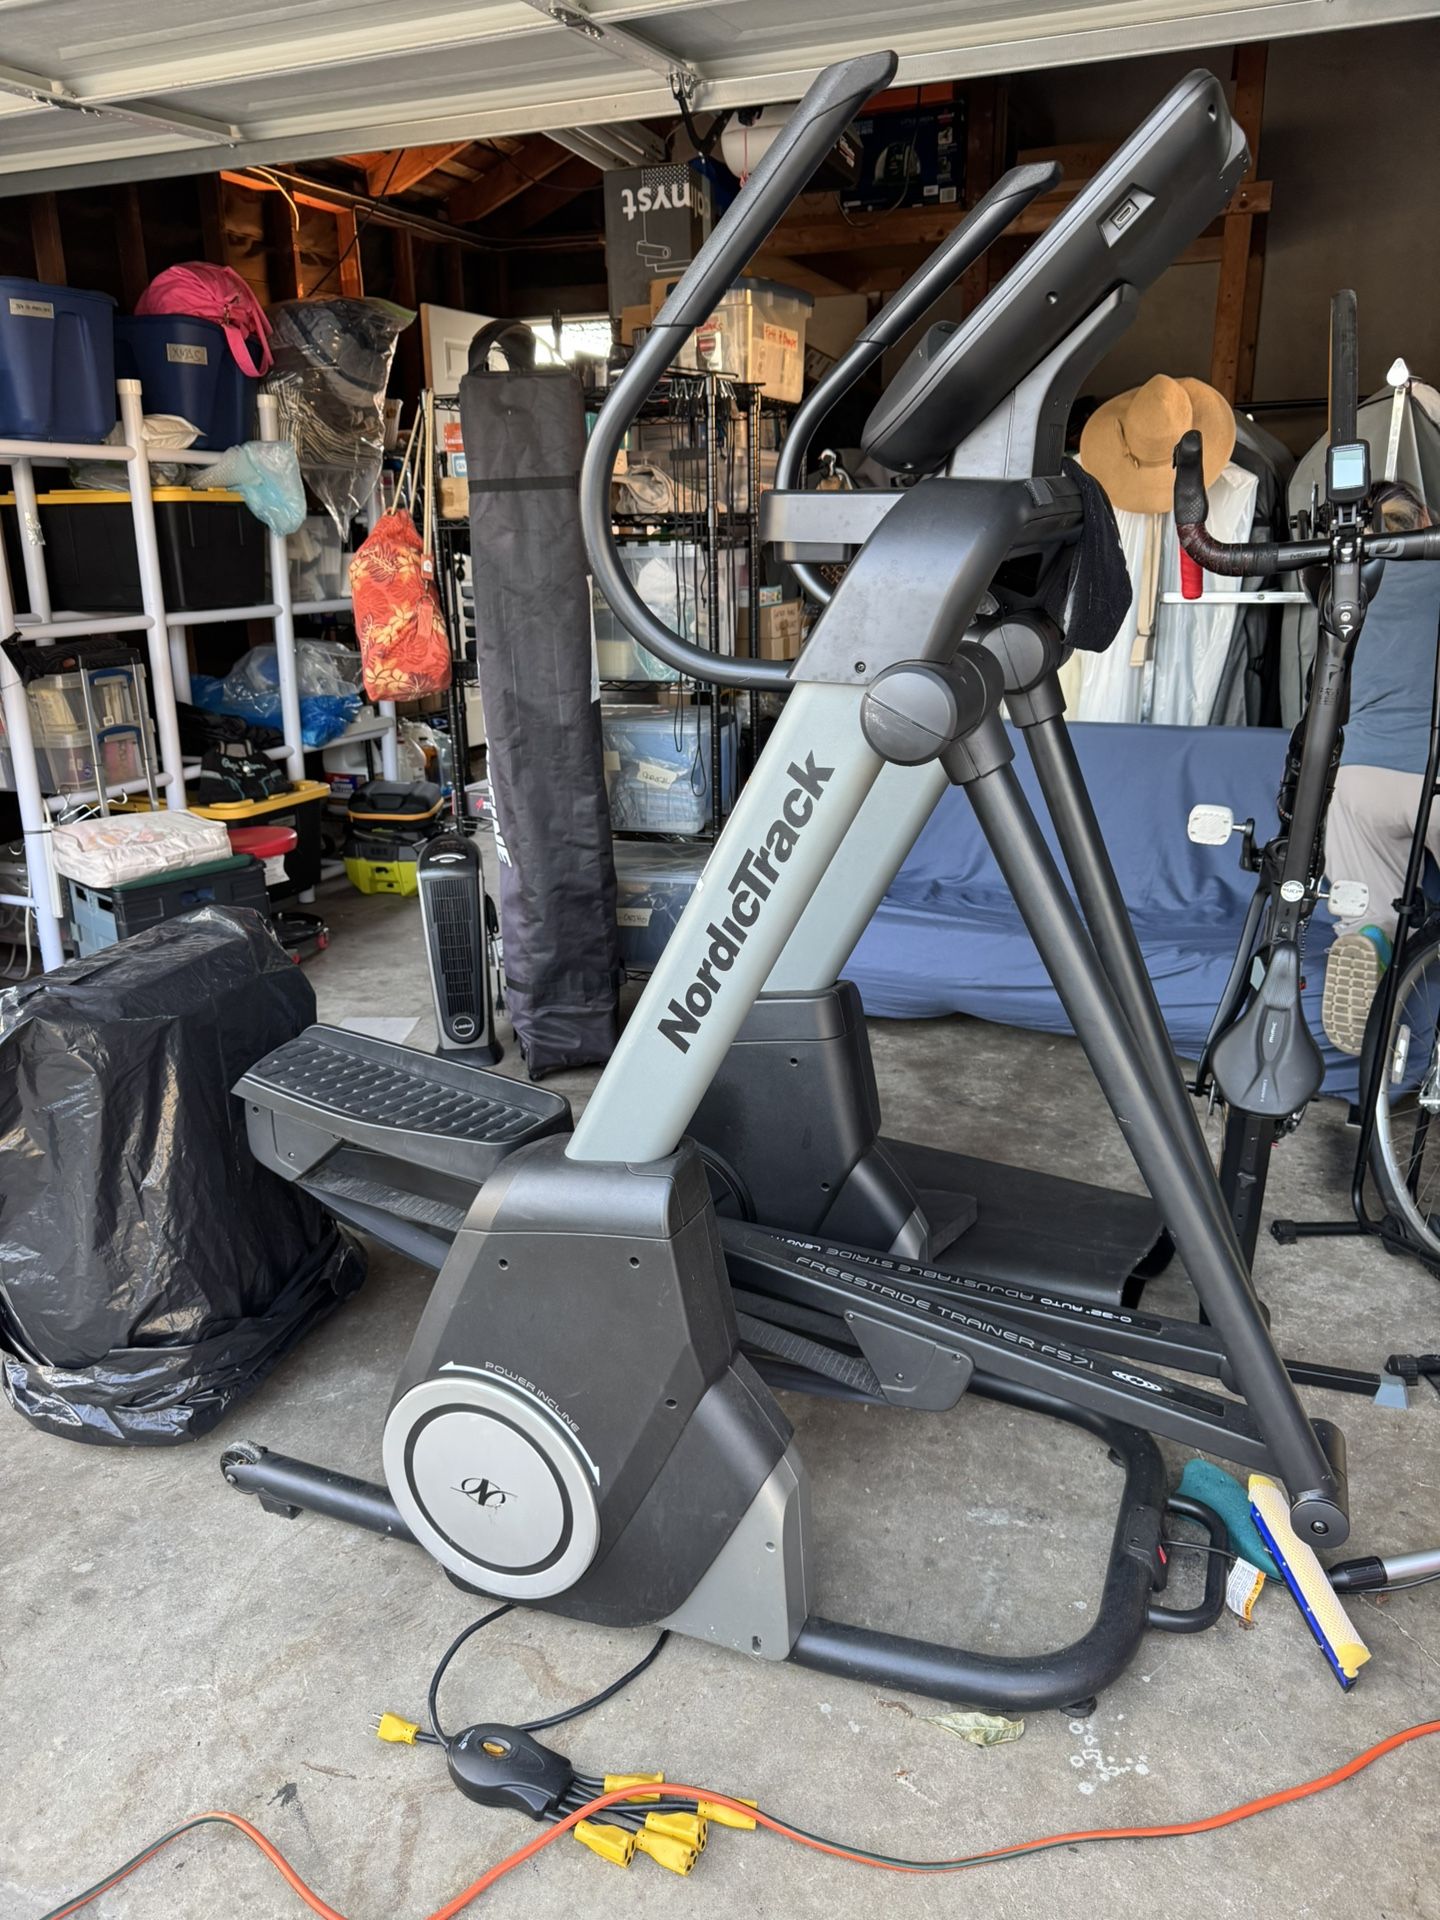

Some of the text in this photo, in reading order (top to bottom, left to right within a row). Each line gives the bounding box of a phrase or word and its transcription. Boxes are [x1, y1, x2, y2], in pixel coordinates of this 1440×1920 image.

[657, 749, 836, 1055] NordicTrack
[826, 1247, 894, 1269] STRIDE
[898, 1264, 1034, 1301] ADJUSTABLE
[796, 1256, 931, 1310] FREESTRIDE
[937, 1306, 1035, 1348] TRAINER
[1040, 1297, 1083, 1312] AUTO
[485, 1361, 580, 1432] POWER INCLINE
